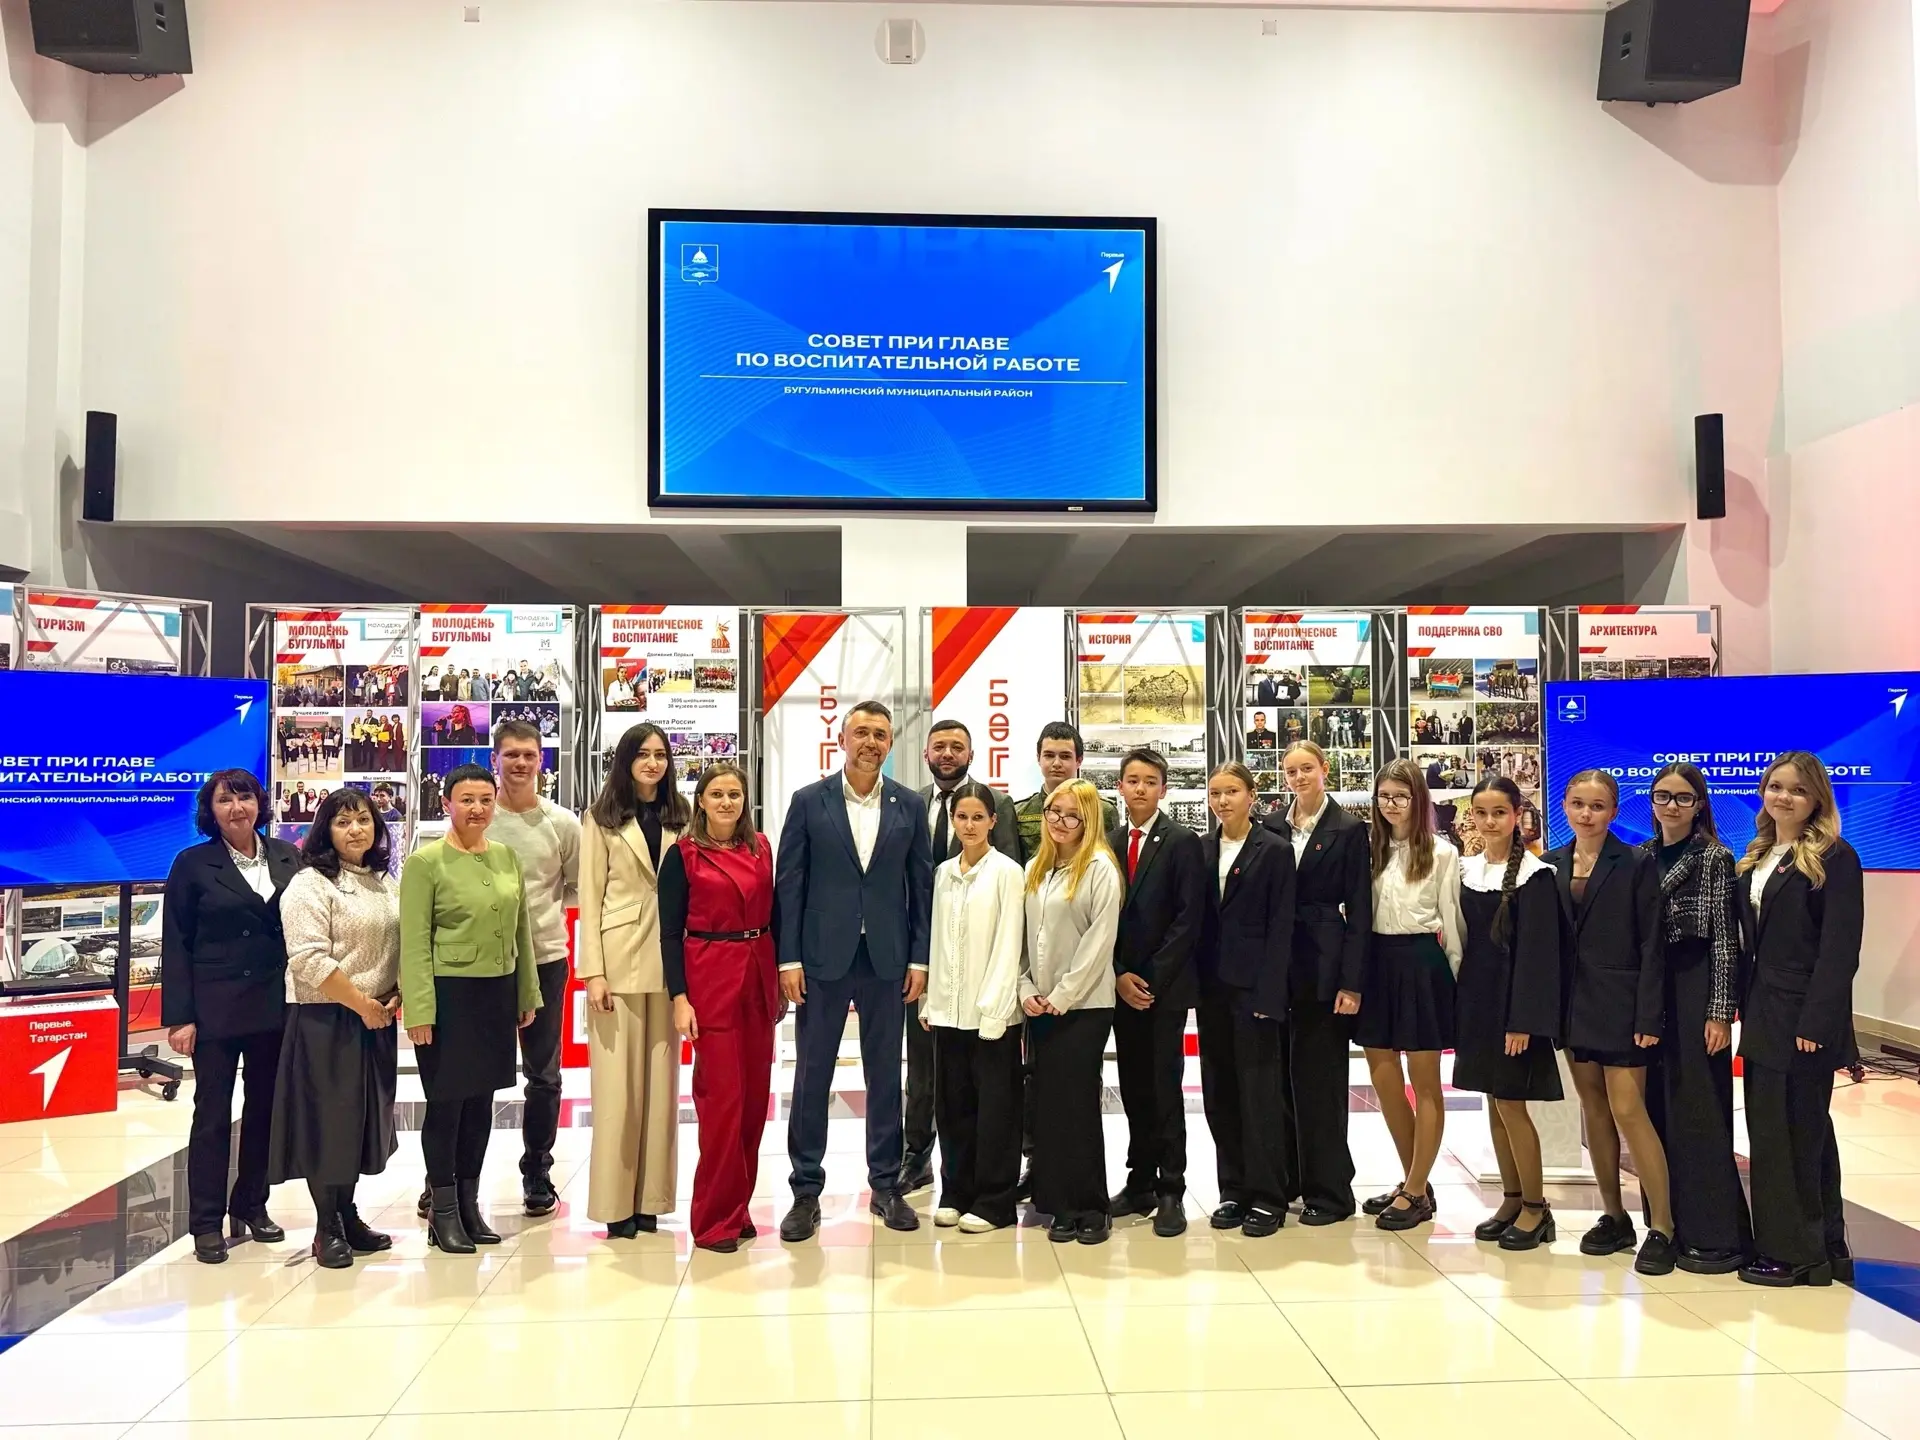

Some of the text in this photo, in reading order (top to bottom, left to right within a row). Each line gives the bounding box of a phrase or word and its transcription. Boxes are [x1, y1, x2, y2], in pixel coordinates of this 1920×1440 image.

[807, 333, 1010, 351] СОВЕТ ПРИ ГЛАВЕ
[736, 352, 1080, 371] ПО ВОСПИТАТЕЛЬНОЙ РАБОТЕ
[784, 384, 1033, 398] БУГУЛЬМИНСКИЙ МУНИЦИПАЛЬНЫЙ РАЙОН
[36, 617, 86, 632] ТУРИЗМ
[613, 619, 703, 630] ПАТРИОТИЧЕСКОЕ
[1253, 627, 1338, 638] ПАТРИОТИЧЕСКОЕ
[1418, 625, 1503, 638] ПОДДЕРЖКА СВО
[1590, 625, 1658, 637] АРХИТЕКТУРА
[432, 632, 491, 642] БУГУЛЬМЫ
[613, 632, 678, 643] ВОСПИТАНИЕ
[1088, 634, 1132, 645] ИСТОРИЯ
[288, 639, 345, 650] БУГУЛЬМЫ
[1253, 640, 1315, 651] ВОСПИТАНИЕ
[0, 756, 155, 768] ВЕТ ПРИ ГЛАВЕ
[1652, 752, 1711, 763] СОВЕТ
[1714, 752, 1751, 762] ПРИ
[43, 796, 139, 804] МУНИЦИПАЛЬНЫЙ
[140, 795, 175, 803] РАЙОН
[29, 1020, 74, 1032] Первые.
[29, 1032, 88, 1044] Татарстан
